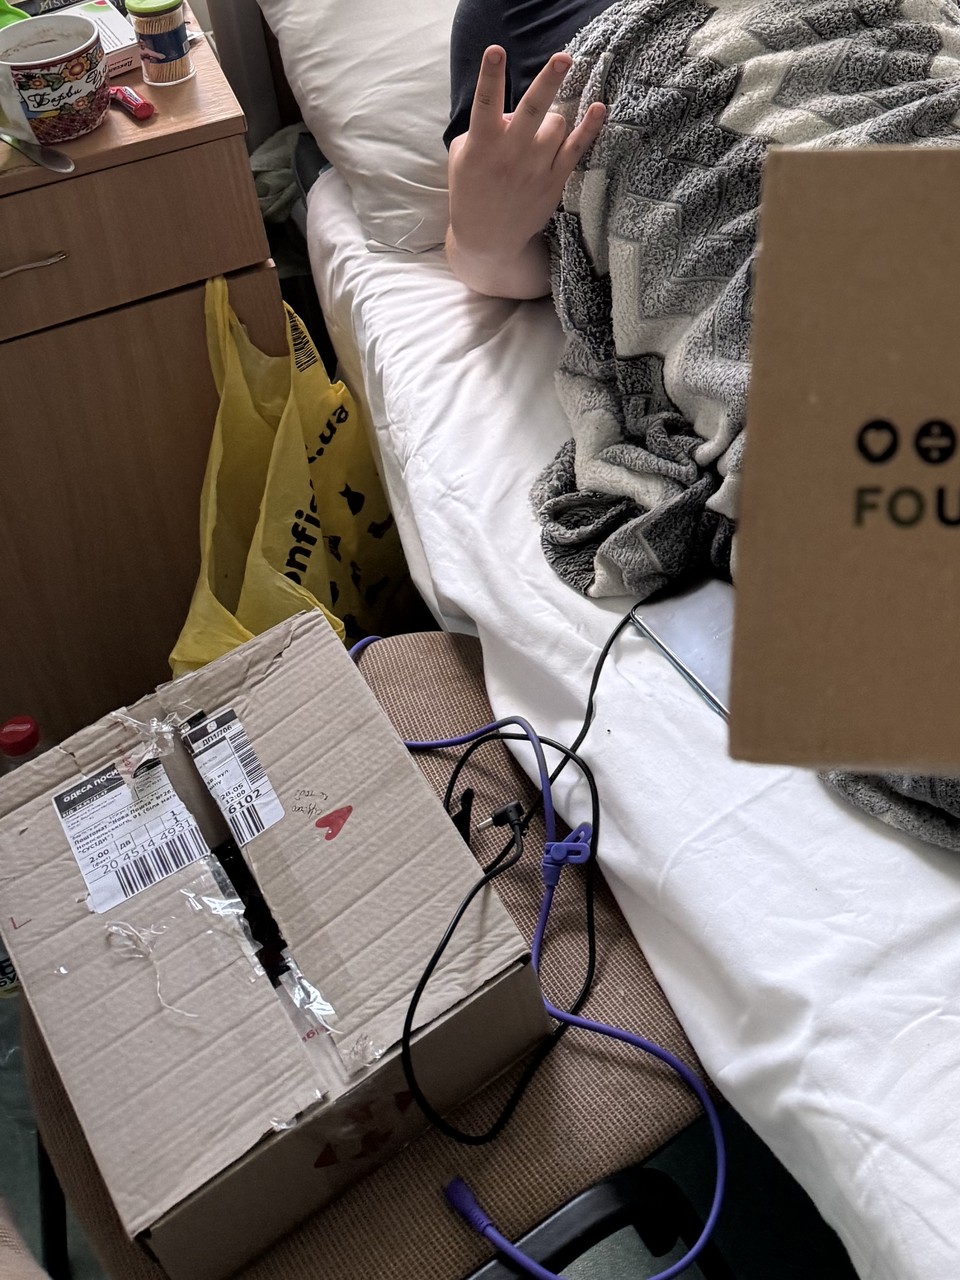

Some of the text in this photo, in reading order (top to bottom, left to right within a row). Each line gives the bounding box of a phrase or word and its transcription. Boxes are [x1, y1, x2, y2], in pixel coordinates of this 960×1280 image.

[27, 85, 82, 108] Барви
[63, 784, 92, 802] ОДЕСА
[94, 769, 119, 785] ПОСИ
[227, 789, 262, 813] 6102
[89, 849, 109, 863] 2.00
[101, 819, 192, 873] 20 4514 4931
